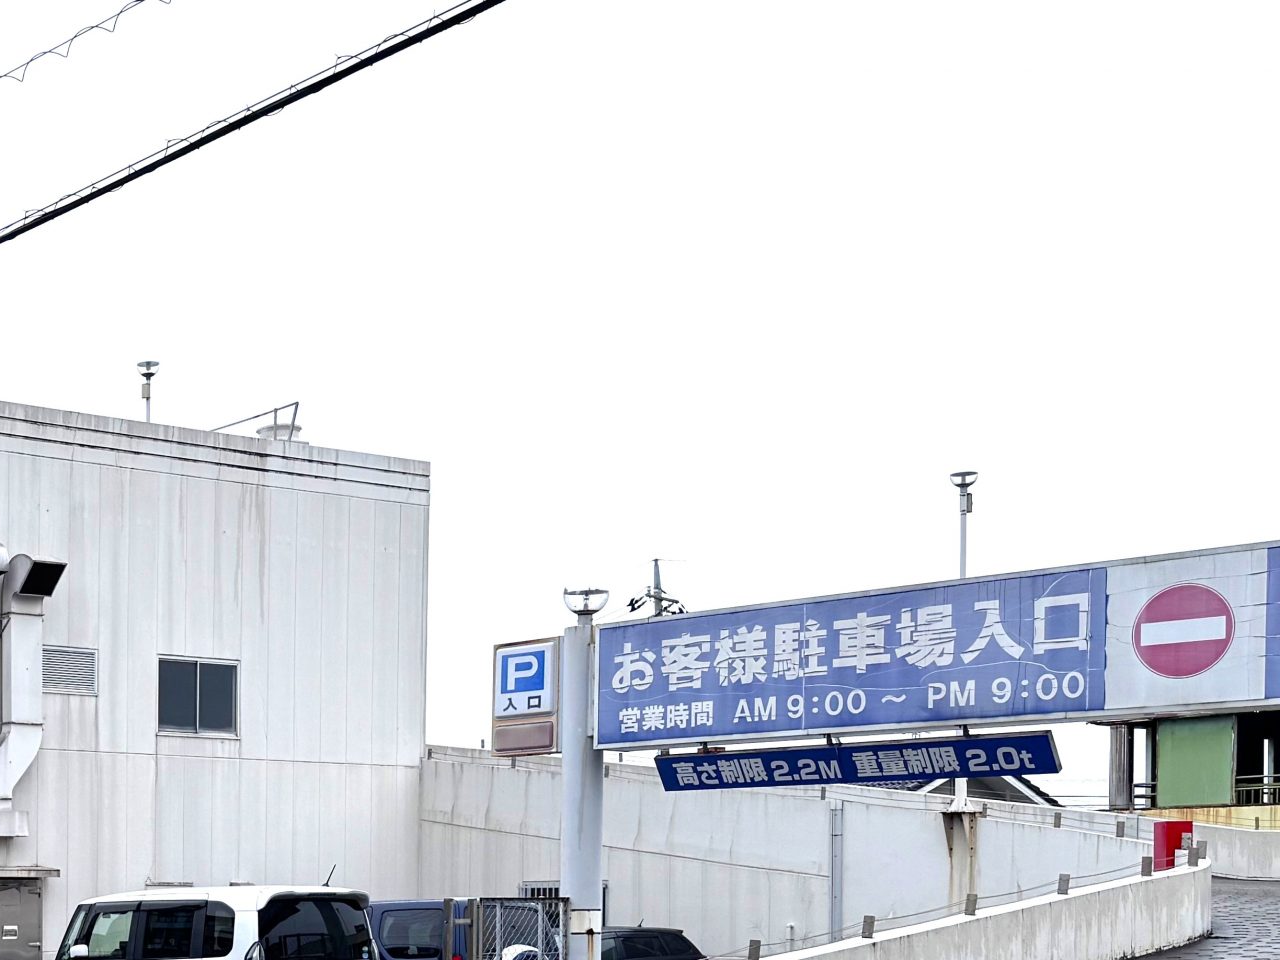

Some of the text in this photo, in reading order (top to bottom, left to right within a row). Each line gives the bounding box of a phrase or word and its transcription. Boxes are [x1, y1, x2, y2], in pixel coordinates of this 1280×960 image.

[612, 593, 1091, 694] お客様駐車場入口
[506, 655, 539, 691] P
[503, 695, 542, 712] 入口
[619, 701, 714, 734] 営業時間
[733, 696, 777, 723] AM
[787, 688, 866, 719] 9:00
[927, 679, 976, 709] PM
[991, 671, 1085, 704] 9:00
[672, 746, 1036, 787] 高さ制限 2.2M 重量制限 2.0t
